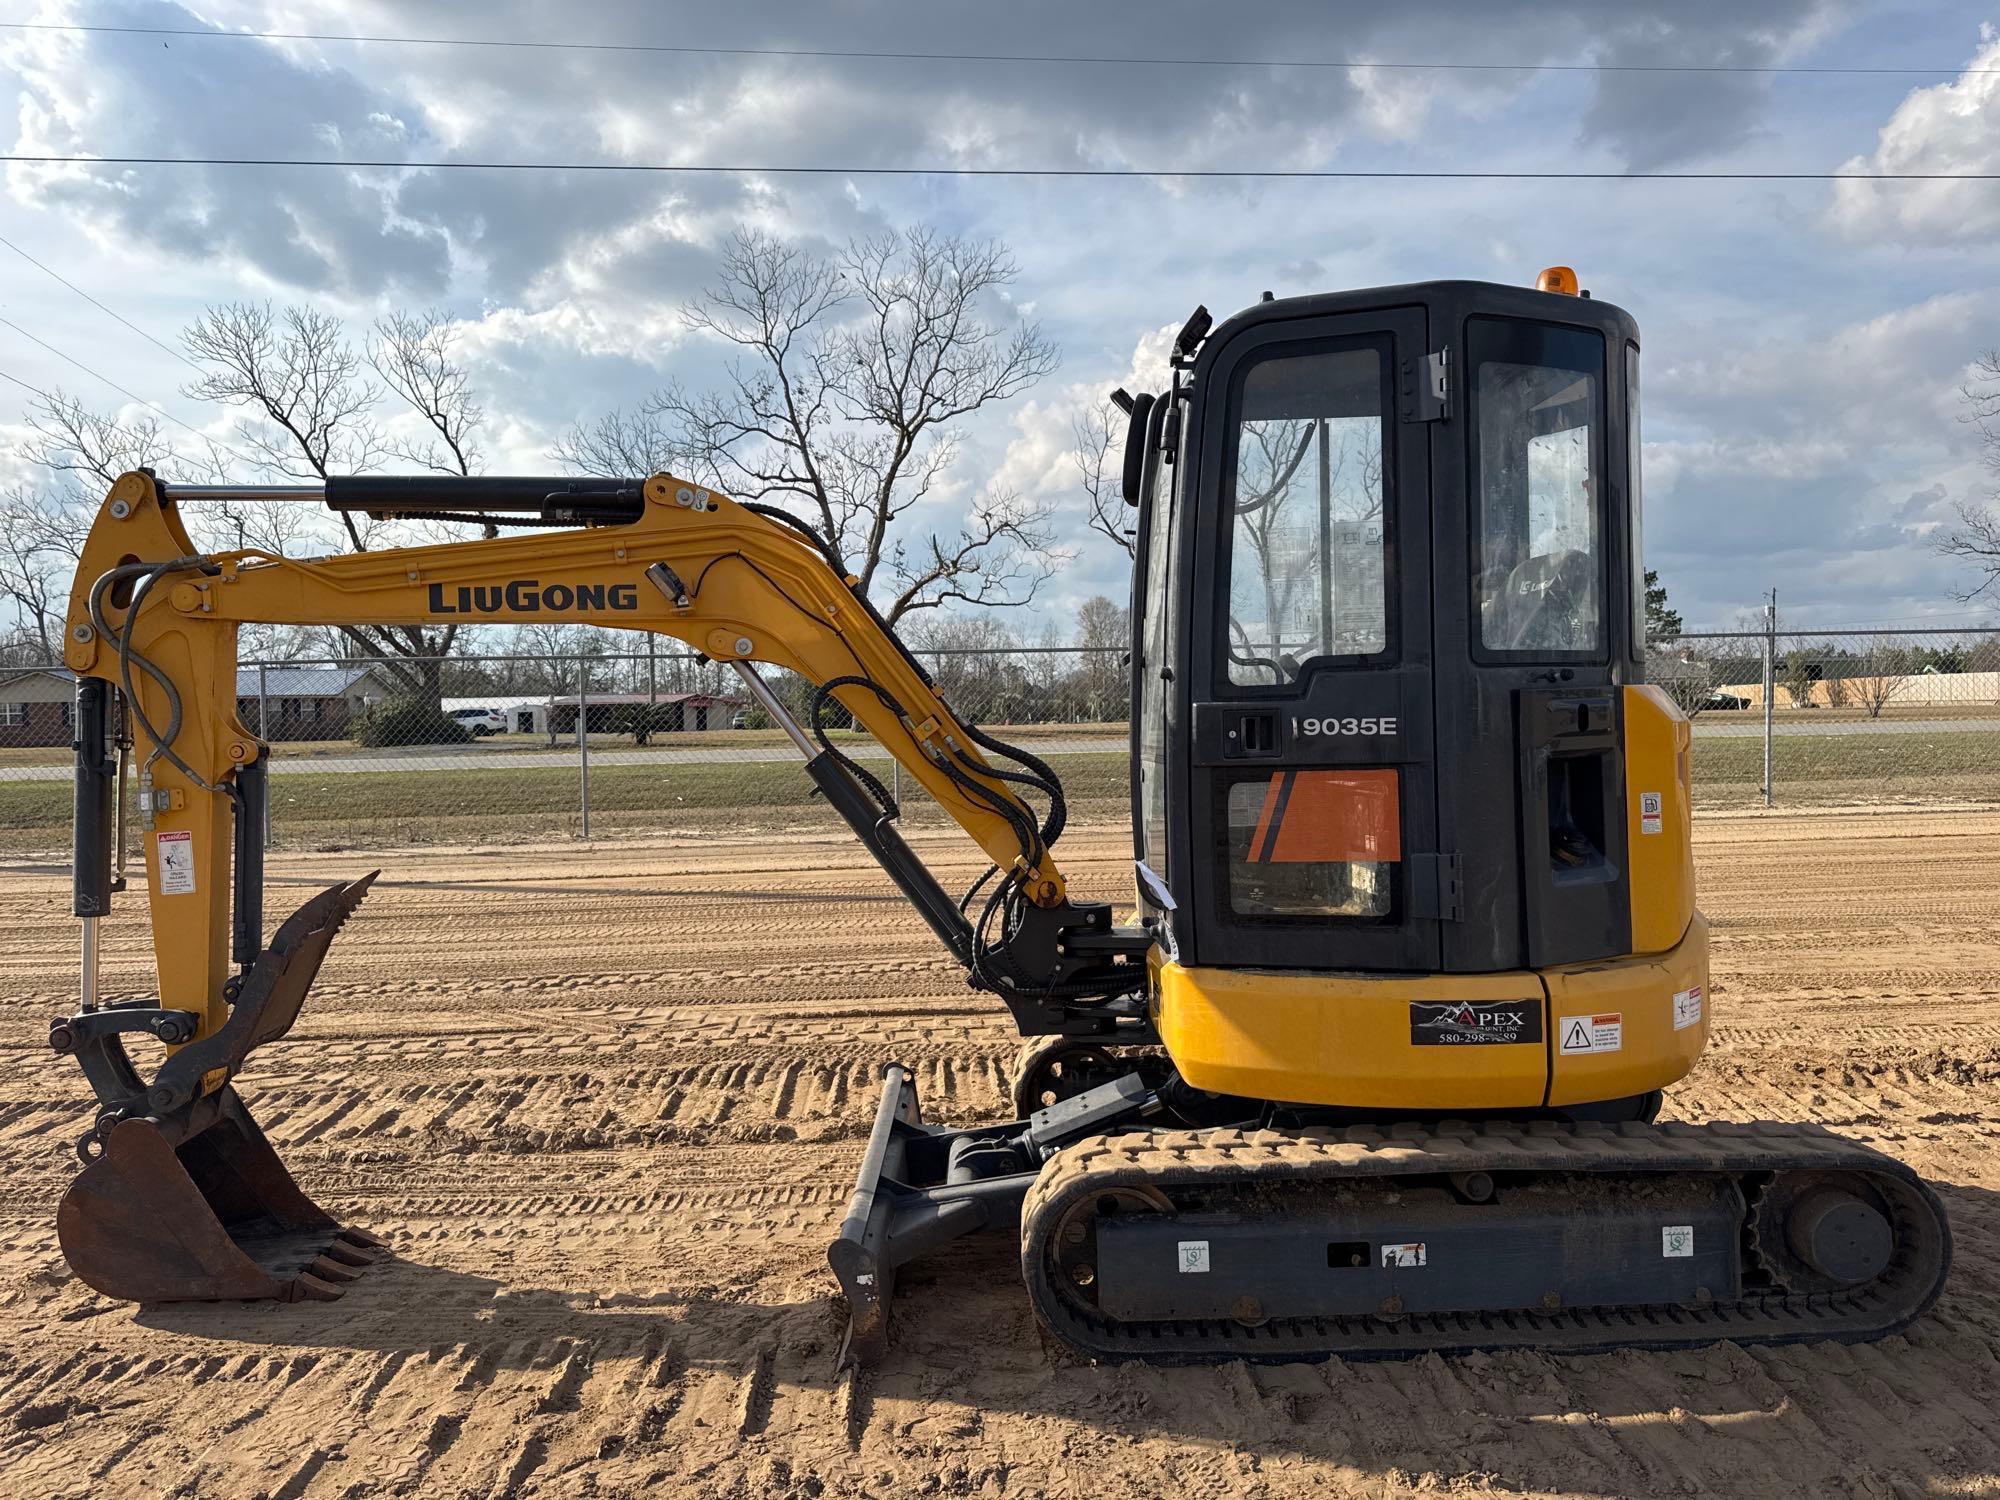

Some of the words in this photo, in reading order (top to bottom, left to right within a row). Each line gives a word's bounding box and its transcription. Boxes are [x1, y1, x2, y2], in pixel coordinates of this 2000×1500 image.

[1302, 718, 1396, 736] 9035E
[1457, 1010, 1525, 1026] APEX
[1439, 1032, 1517, 1043] 580-298-89
